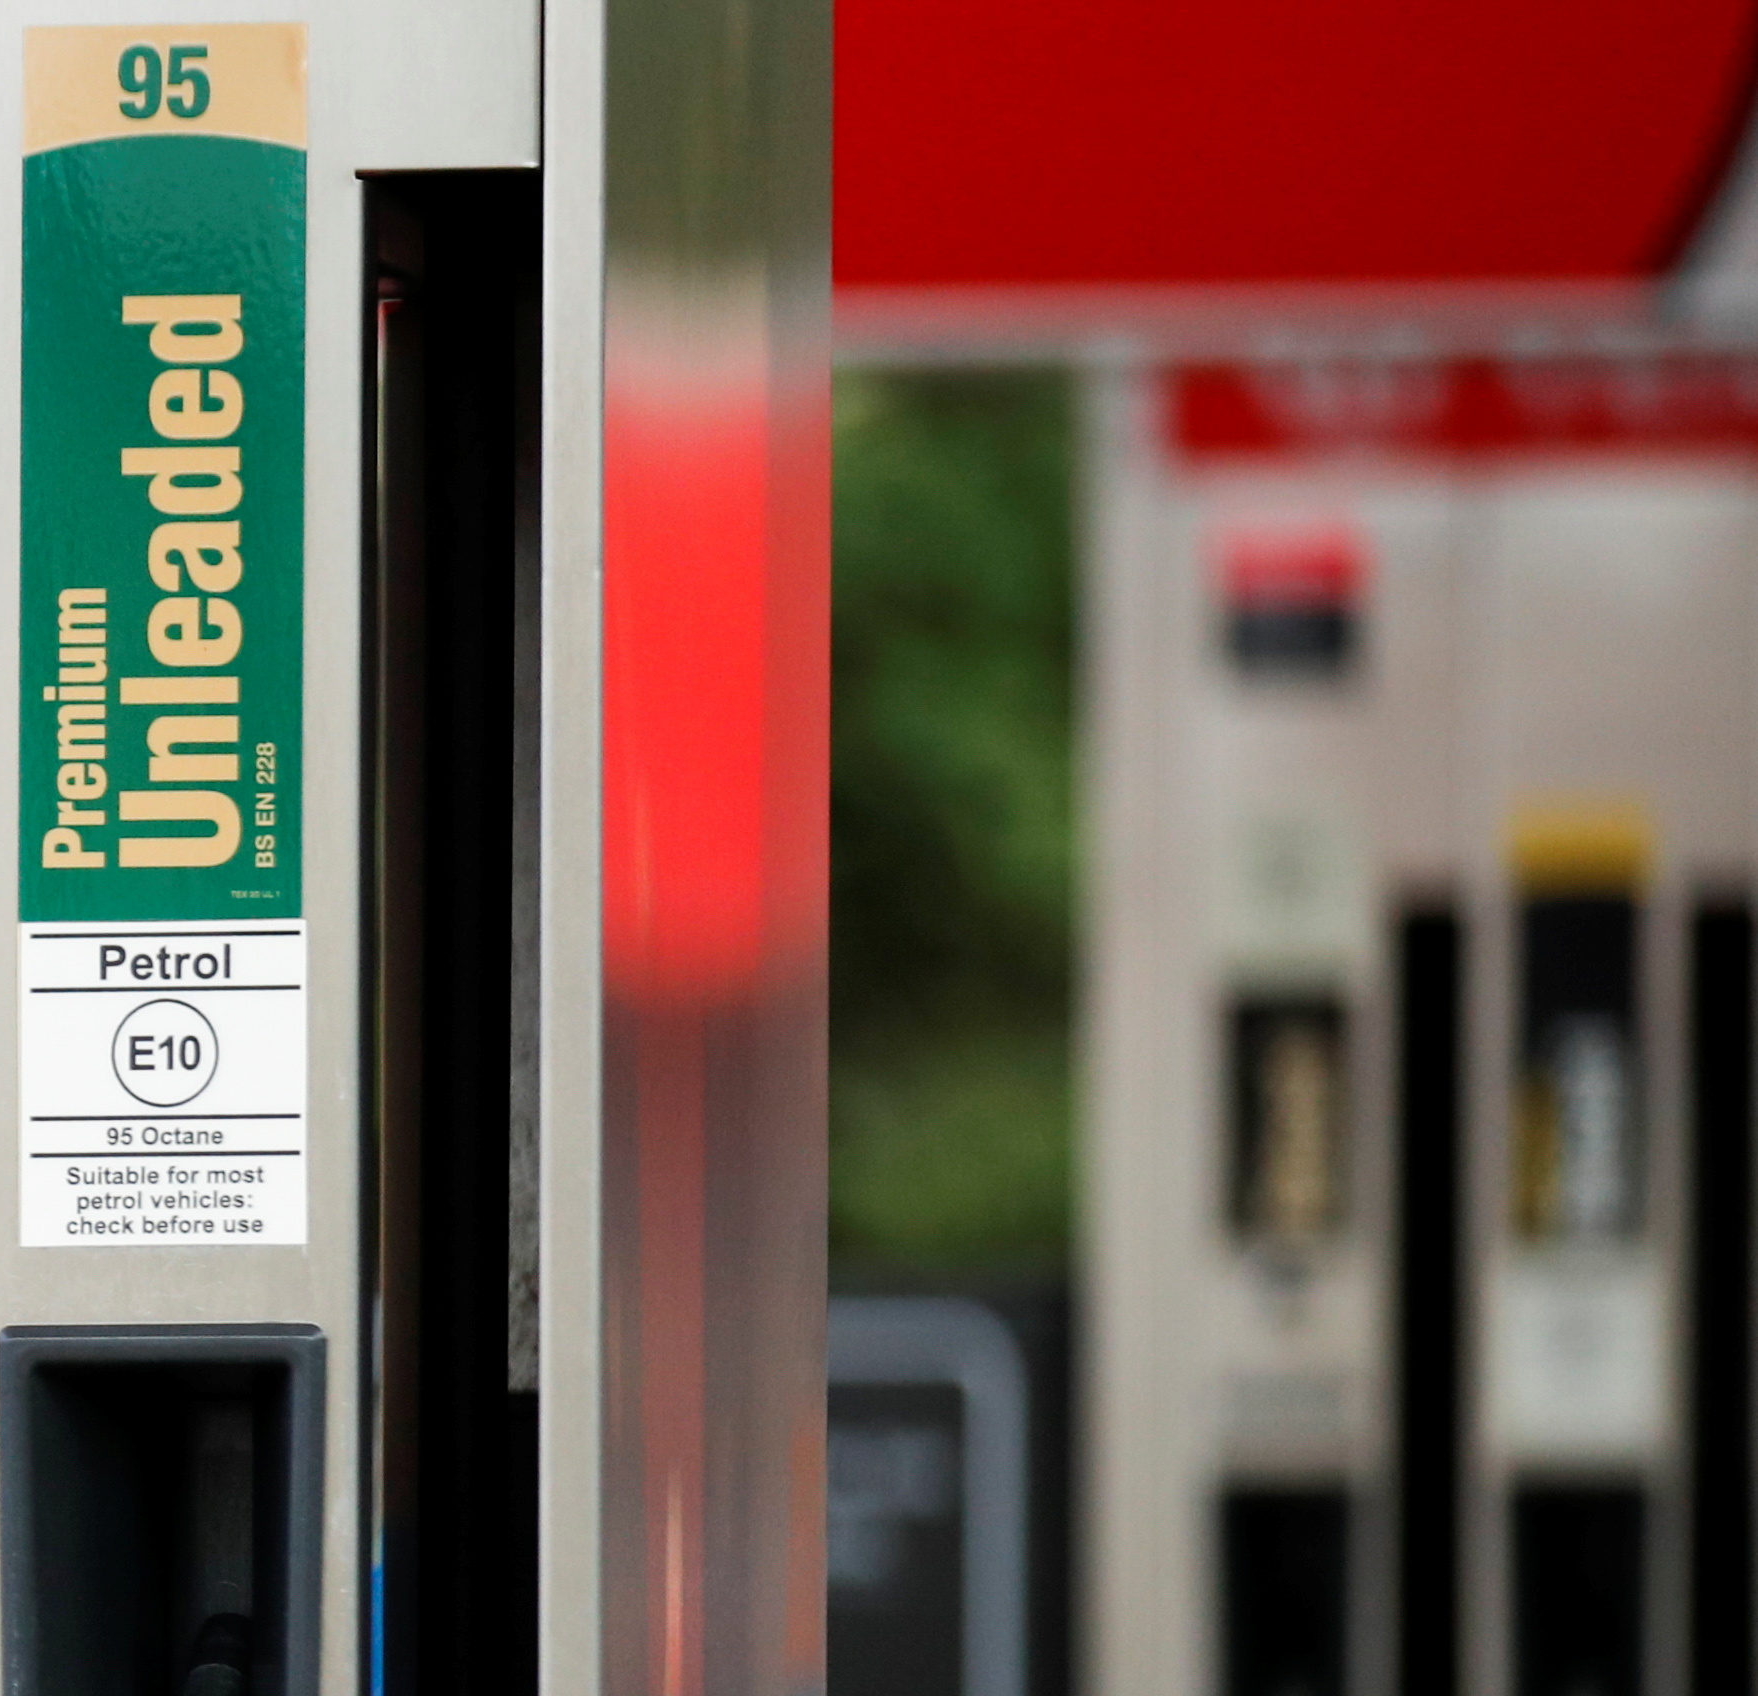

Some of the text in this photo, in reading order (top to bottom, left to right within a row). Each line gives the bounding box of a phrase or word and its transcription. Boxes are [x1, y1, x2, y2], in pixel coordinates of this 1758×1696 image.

[118, 46, 210, 120] 95
[119, 294, 244, 868] Unleaded
[42, 588, 108, 868] Premium
[255, 742, 276, 867] BS EN 228
[100, 944, 230, 980] Petrol
[130, 1036, 200, 1070] E10
[107, 1127, 223, 1145] 95 Octane
[67, 1166, 263, 1185] Suitable for most
[78, 1191, 251, 1214] petrol vehicles:
[67, 1216, 263, 1234] check before use
